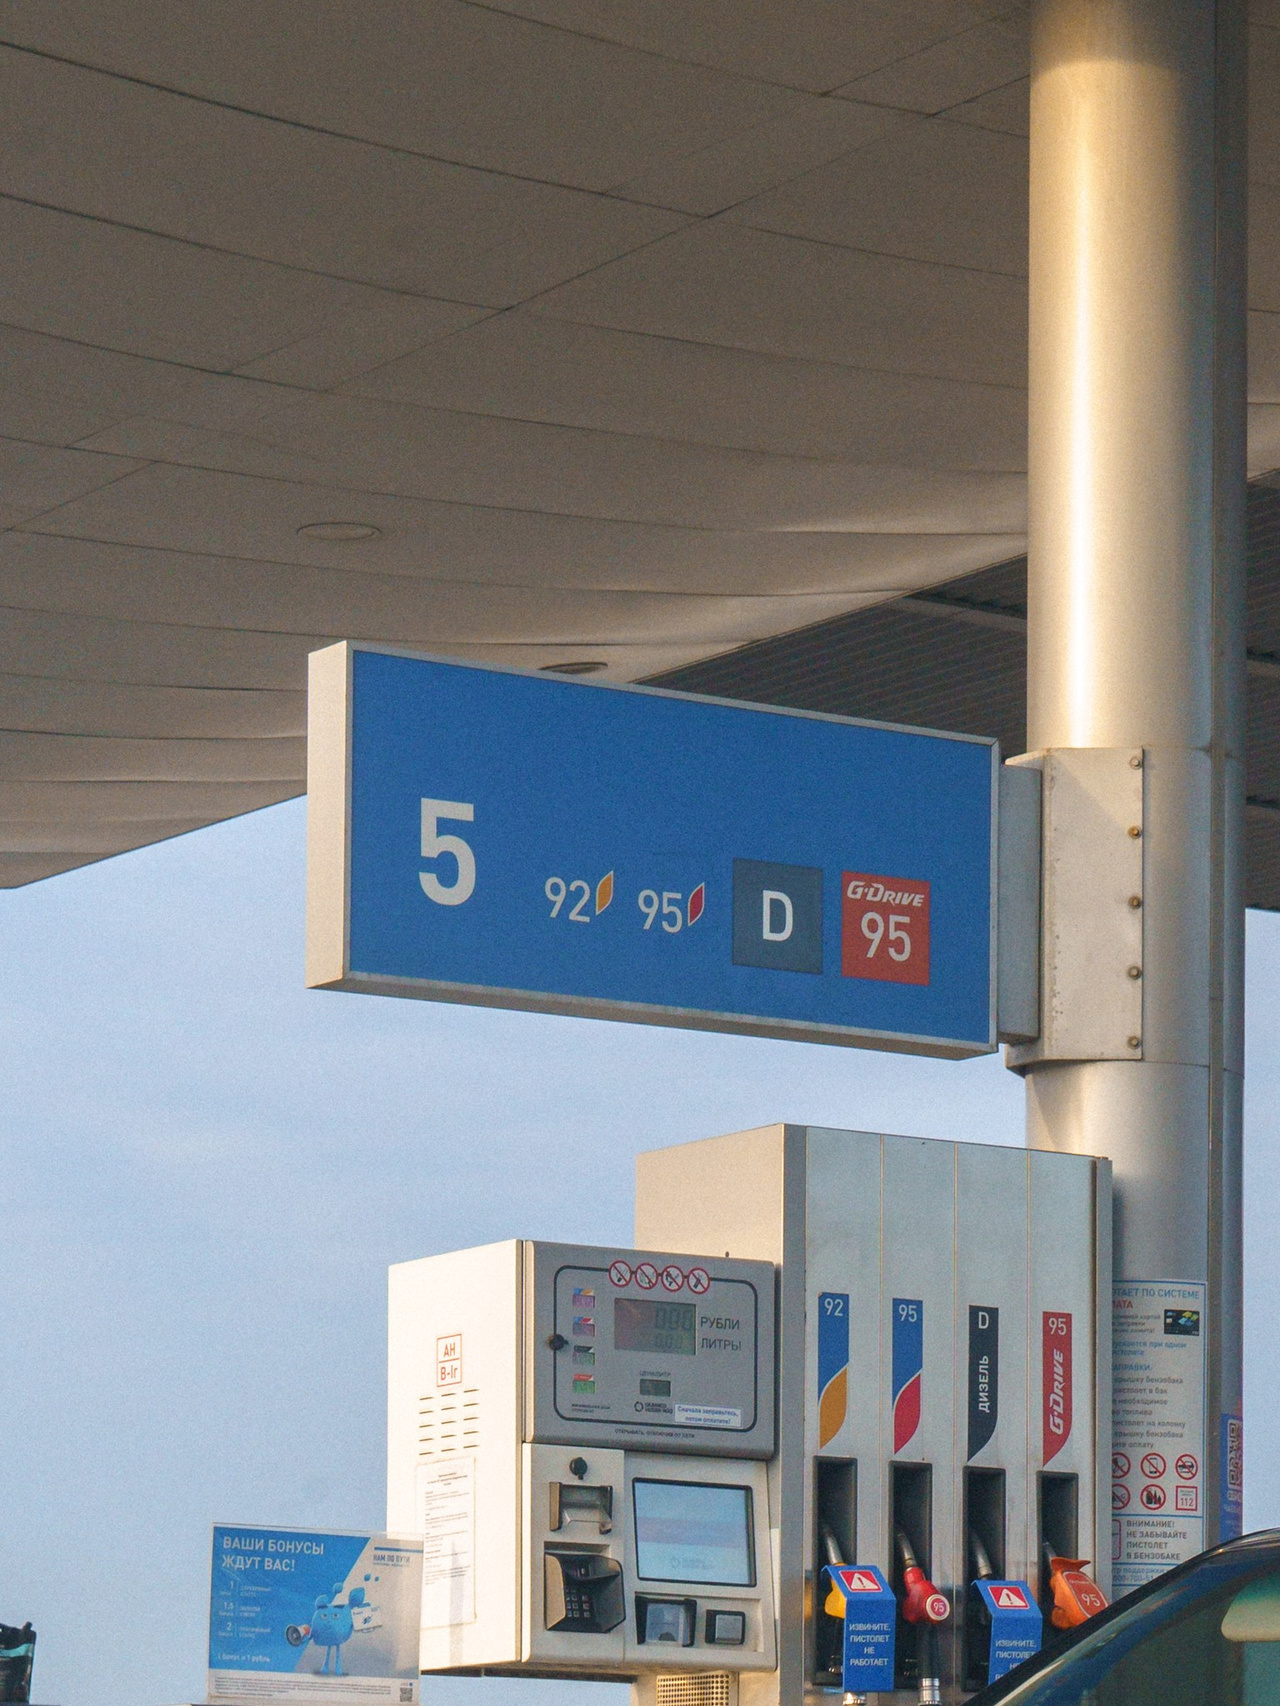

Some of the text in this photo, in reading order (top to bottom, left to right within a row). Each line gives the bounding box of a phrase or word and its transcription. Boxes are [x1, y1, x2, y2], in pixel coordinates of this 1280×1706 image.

[418, 797, 476, 906] 5
[545, 876, 591, 923] 92
[637, 889, 683, 933] 95
[762, 889, 794, 942] D
[860, 911, 912, 962] 95
[1142, 1288, 1156, 1297] ПО
[1157, 1289, 1200, 1299] СИСТЕМЕ
[824, 1297, 844, 1317] 92
[898, 1304, 918, 1323] 95
[700, 1316, 741, 1331] РУБЛИ
[978, 1311, 989, 1330] D
[1048, 1317, 1068, 1336] 95
[701, 1337, 742, 1352] ЛИТРЫ
[978, 1355, 990, 1413] ДИЗЕЛЬ
[1180, 1497, 1194, 1507] 112
[1126, 1520, 1175, 1528] ВНИМАНИЕ!
[1138, 1530, 1187, 1539] ЗАБЫВАЙТЕ
[223, 1536, 324, 1555] ВАШИ БОНУСЫ
[222, 1555, 295, 1571] ЖДУТ ВАС!
[933, 1602, 944, 1612] 95
[1081, 1593, 1100, 1607] 95
[849, 1623, 892, 1632] ИЗВИНИТЕ,
[849, 1634, 890, 1643] ПИСТОЛЕТ
[995, 1639, 1037, 1648] ИЗВИНИТЕ,
[863, 1646, 876, 1655] НЕ
[849, 1658, 889, 1667] РАБОТАЕТ
